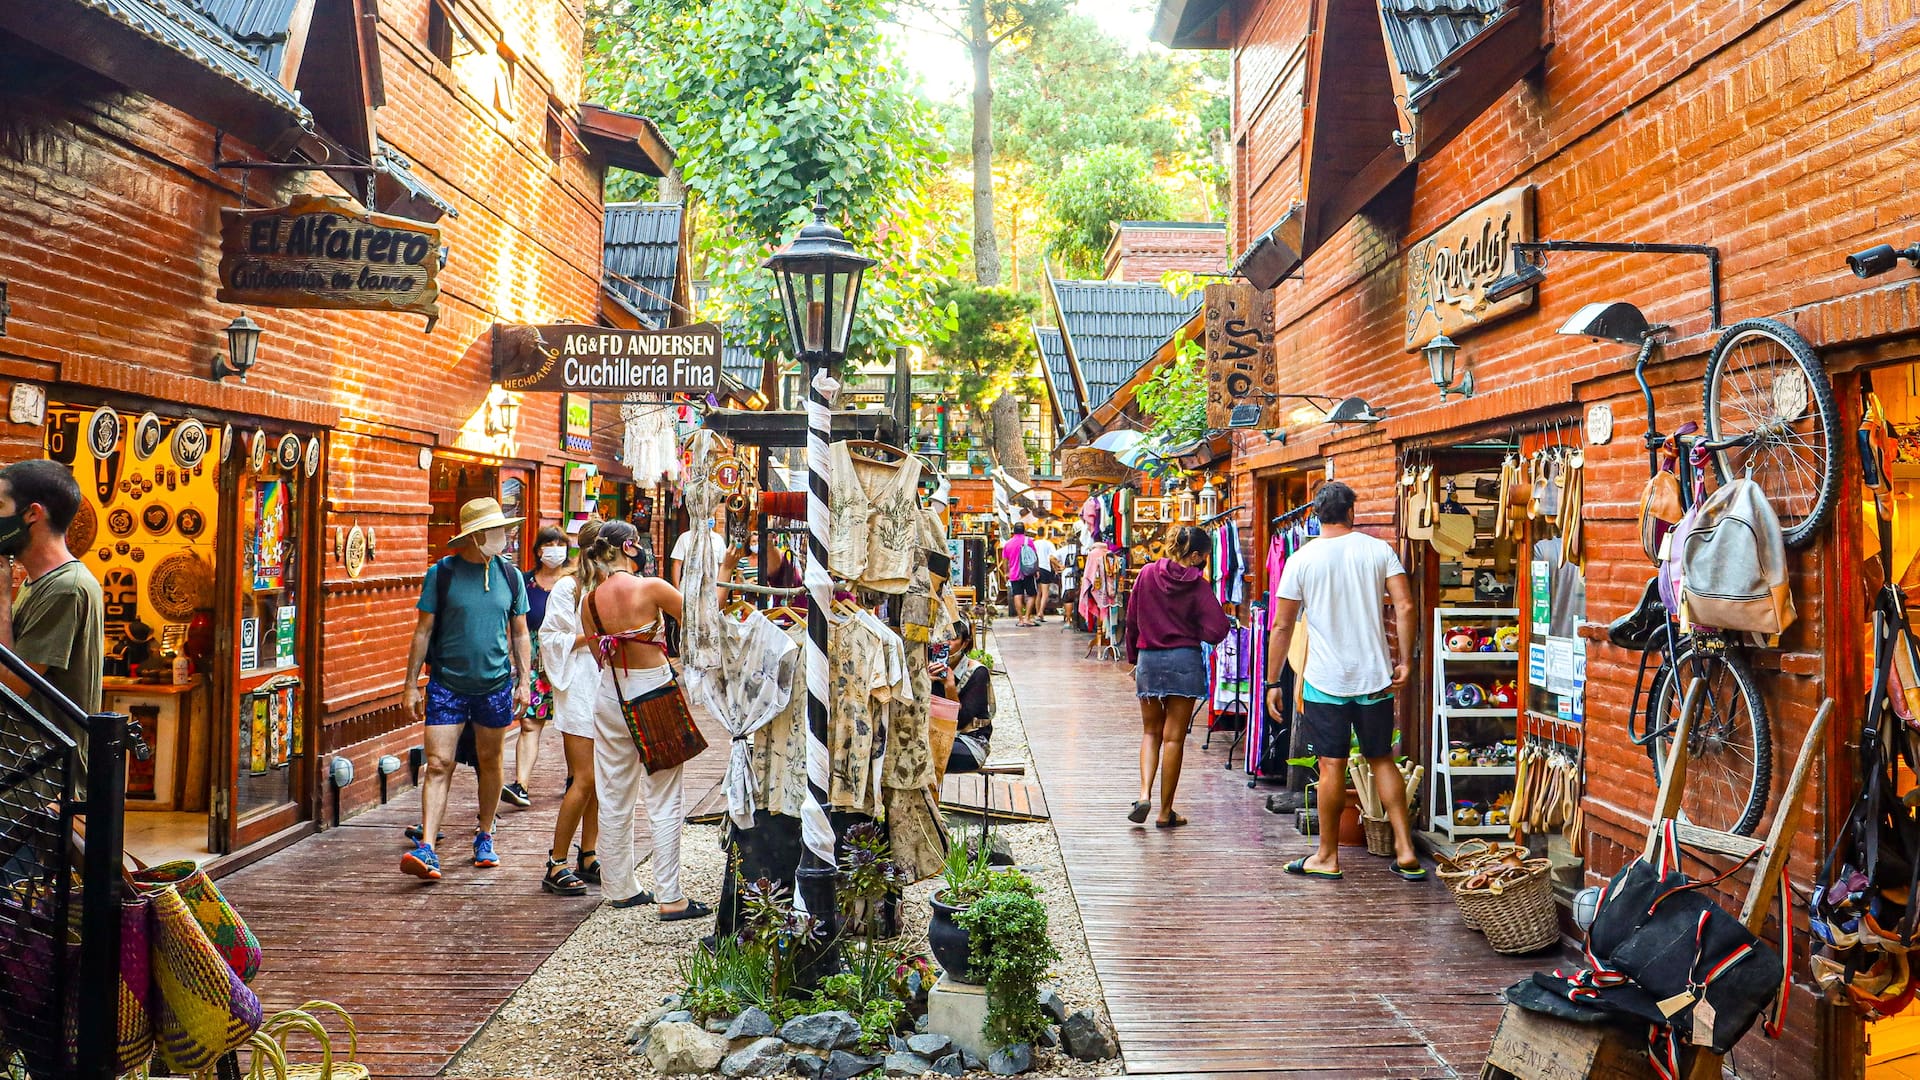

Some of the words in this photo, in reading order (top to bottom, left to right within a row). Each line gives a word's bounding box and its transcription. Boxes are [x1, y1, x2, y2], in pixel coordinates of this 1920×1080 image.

[251, 216, 281, 253] El
[286, 214, 430, 265] Alfarero
[1434, 211, 1511, 306] Rukalaf
[331, 269, 354, 290] en
[356, 265, 417, 292] barro
[627, 335, 715, 356] ANDERSEN
[563, 358, 668, 387] Cuchillería
[673, 358, 715, 387] Fina
